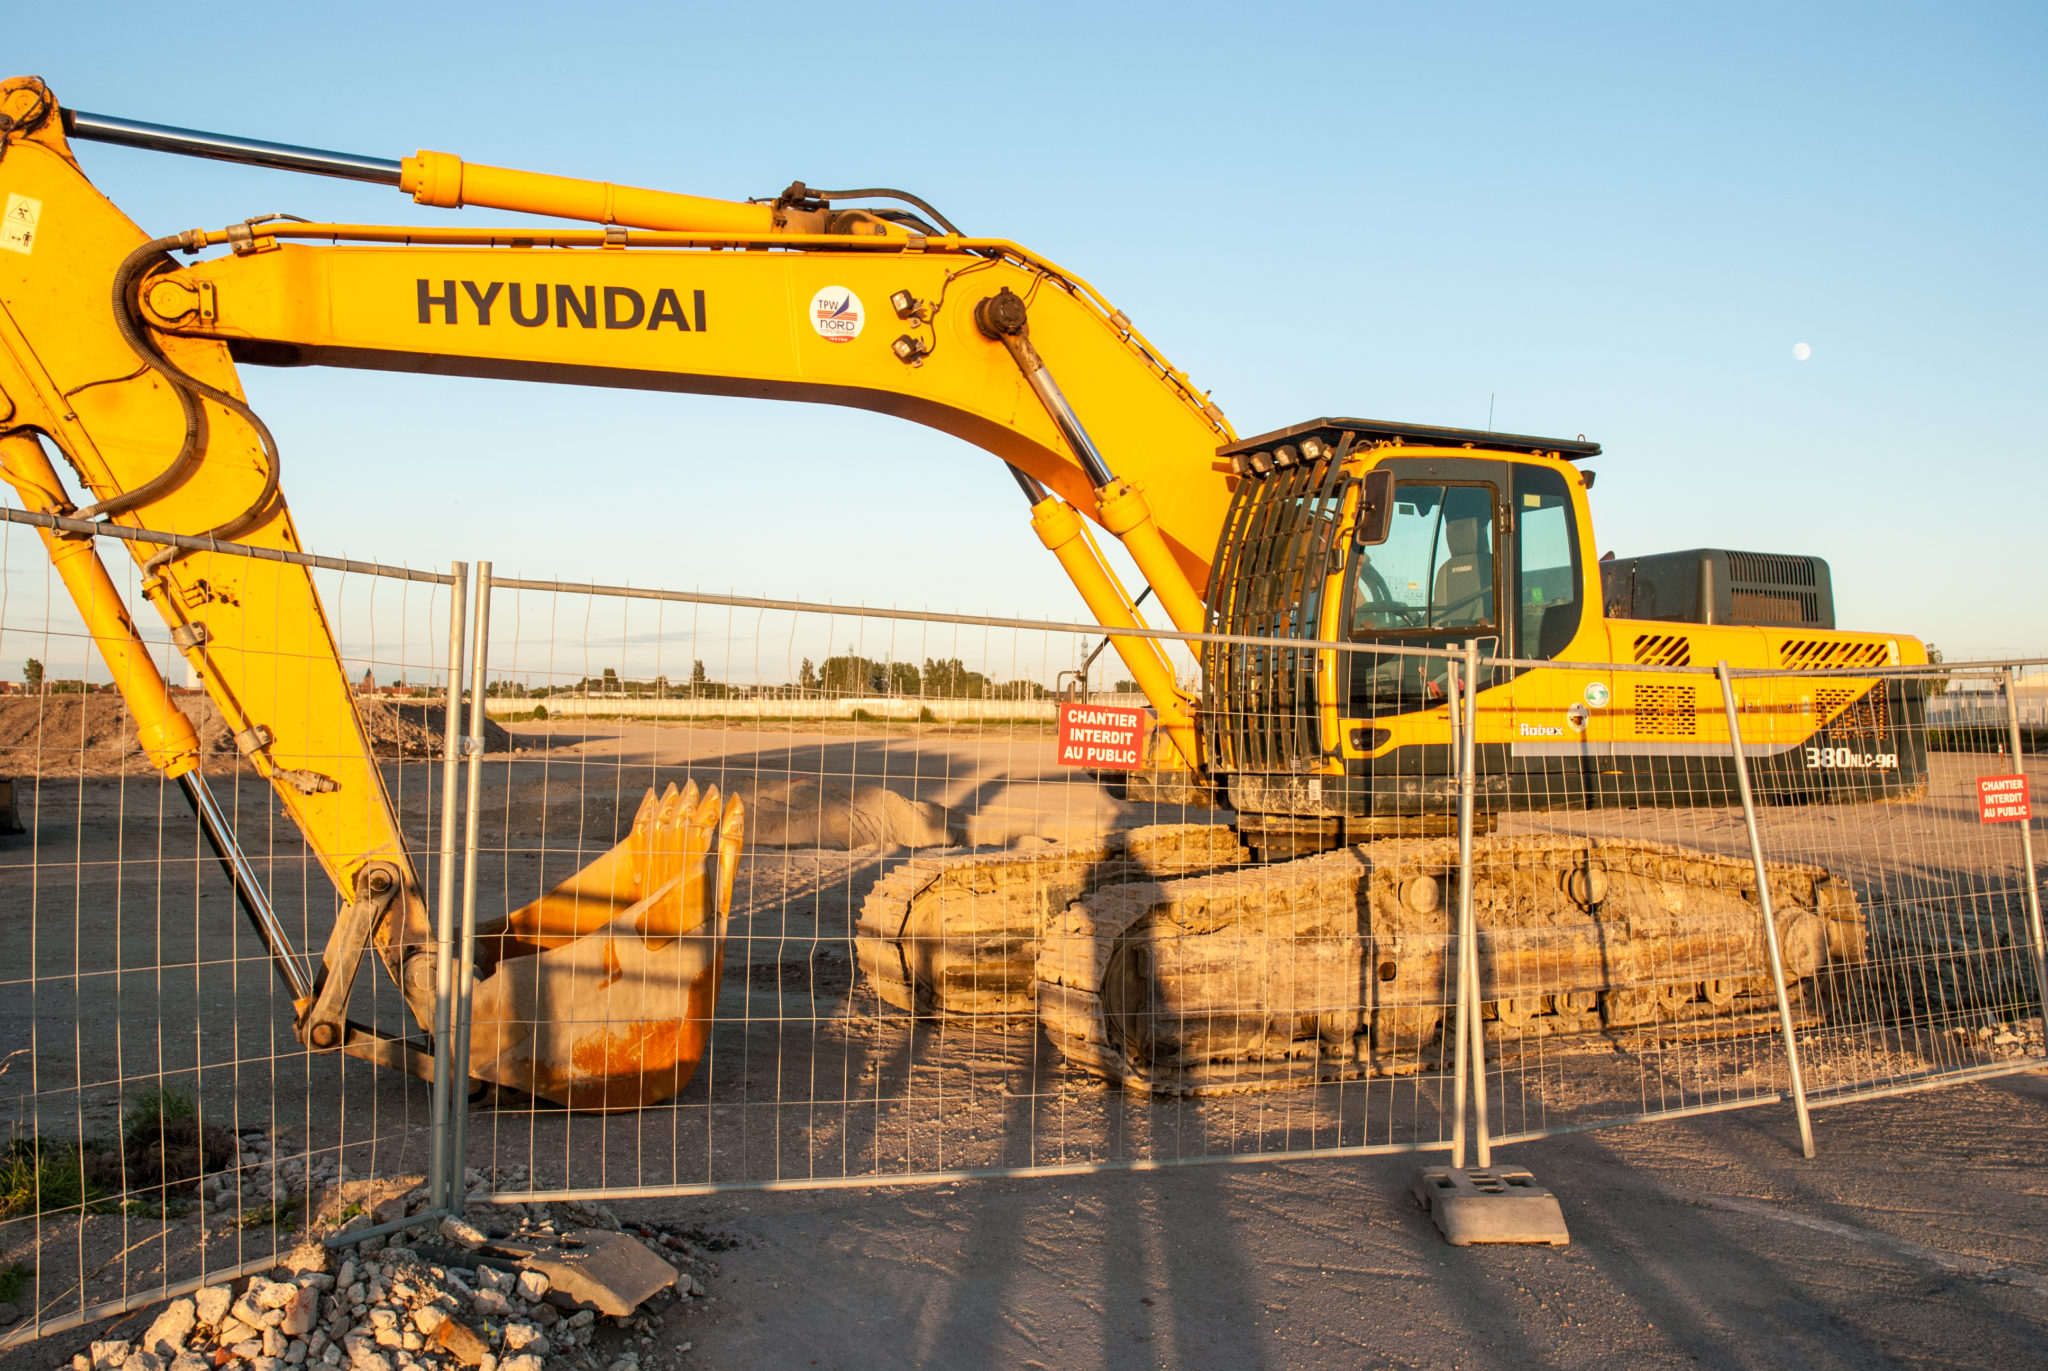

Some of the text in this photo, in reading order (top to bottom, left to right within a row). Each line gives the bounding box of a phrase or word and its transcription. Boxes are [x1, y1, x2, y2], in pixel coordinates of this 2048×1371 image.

[416, 279, 706, 332] HYUNDAI
[818, 299, 839, 310] TPW
[1068, 709, 1137, 728] CHANTIER
[1070, 727, 1133, 745] INTERDIT
[1520, 723, 1563, 736] Robex
[1064, 745, 1136, 764] AU PUBLIC
[1982, 779, 2024, 791] CHANTIER
[1985, 792, 2023, 805] INTERDIT
[1984, 805, 2027, 818] AU PUBLIC
